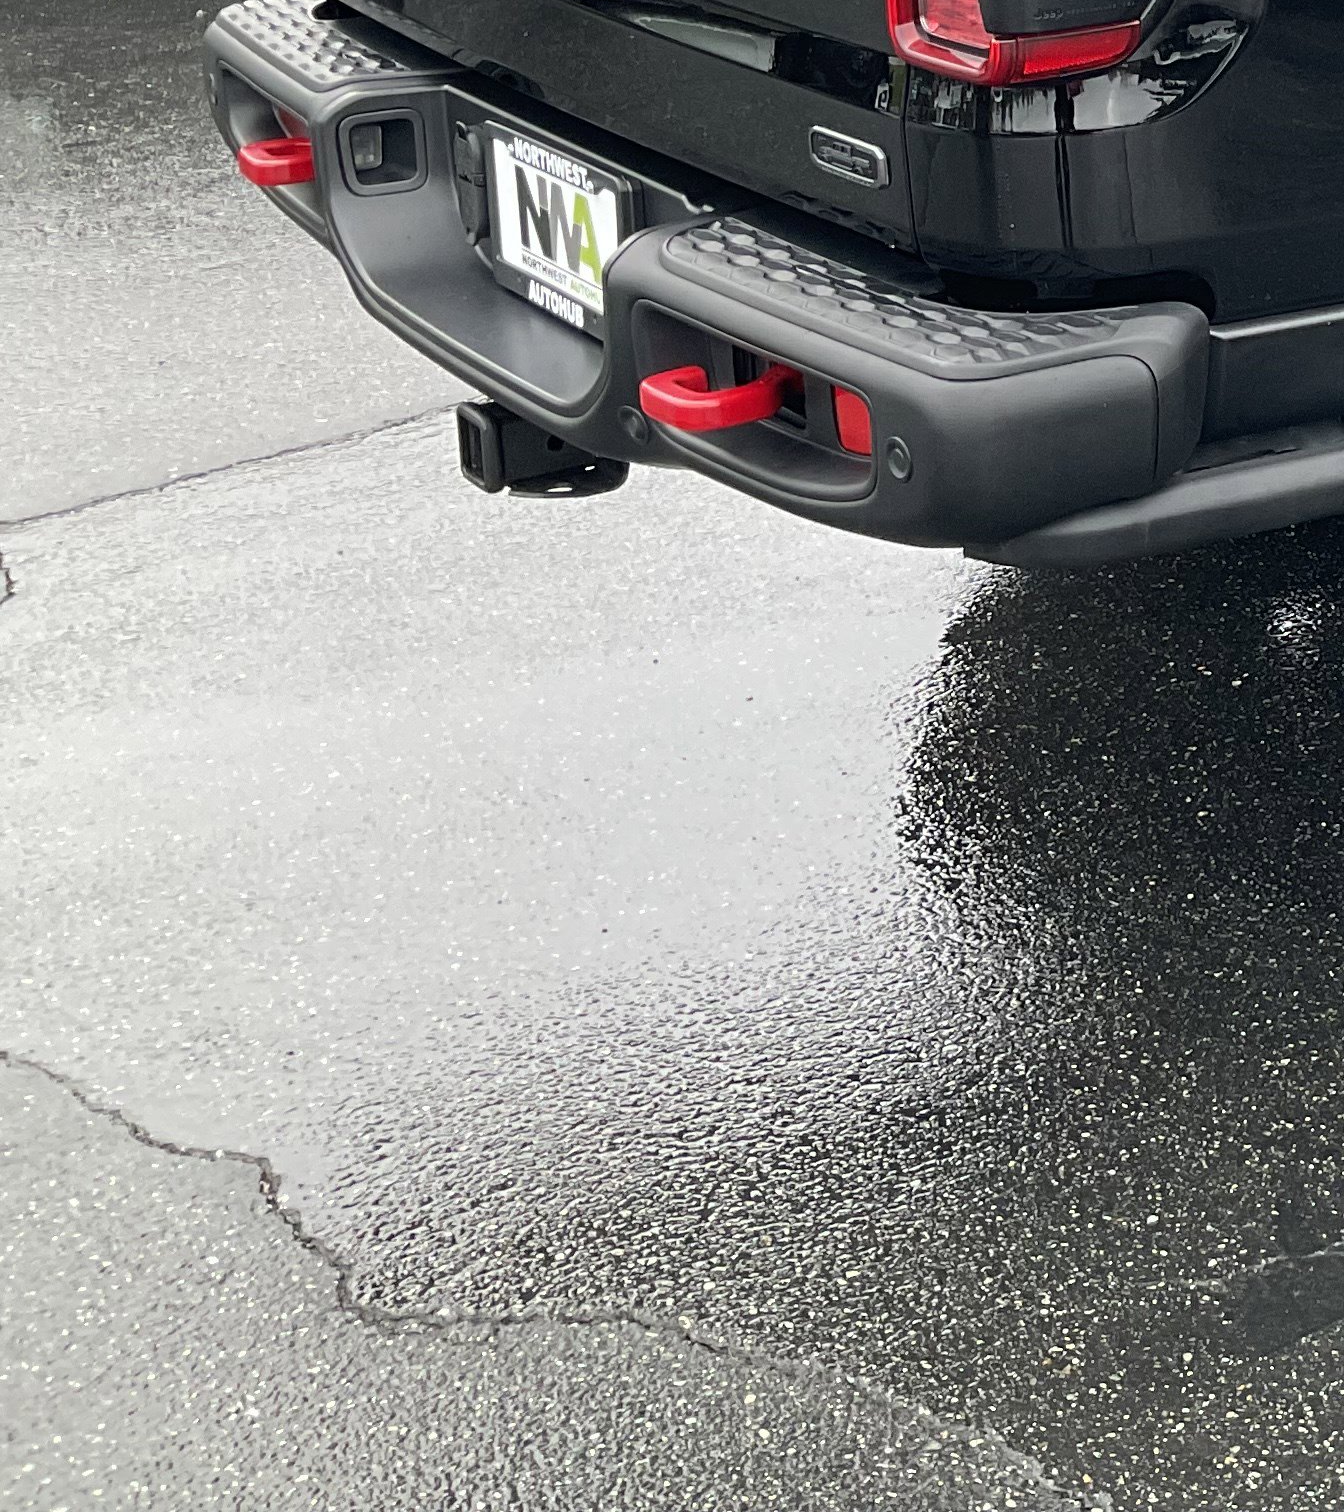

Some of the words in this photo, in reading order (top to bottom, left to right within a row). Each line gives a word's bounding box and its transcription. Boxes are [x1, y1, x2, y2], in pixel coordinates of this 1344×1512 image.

[513, 137, 588, 190] NORTHWEST
[521, 253, 567, 286] NORTHWEST
[570, 278, 602, 305] AUTOHU
[528, 279, 584, 328] AUTOHUB
